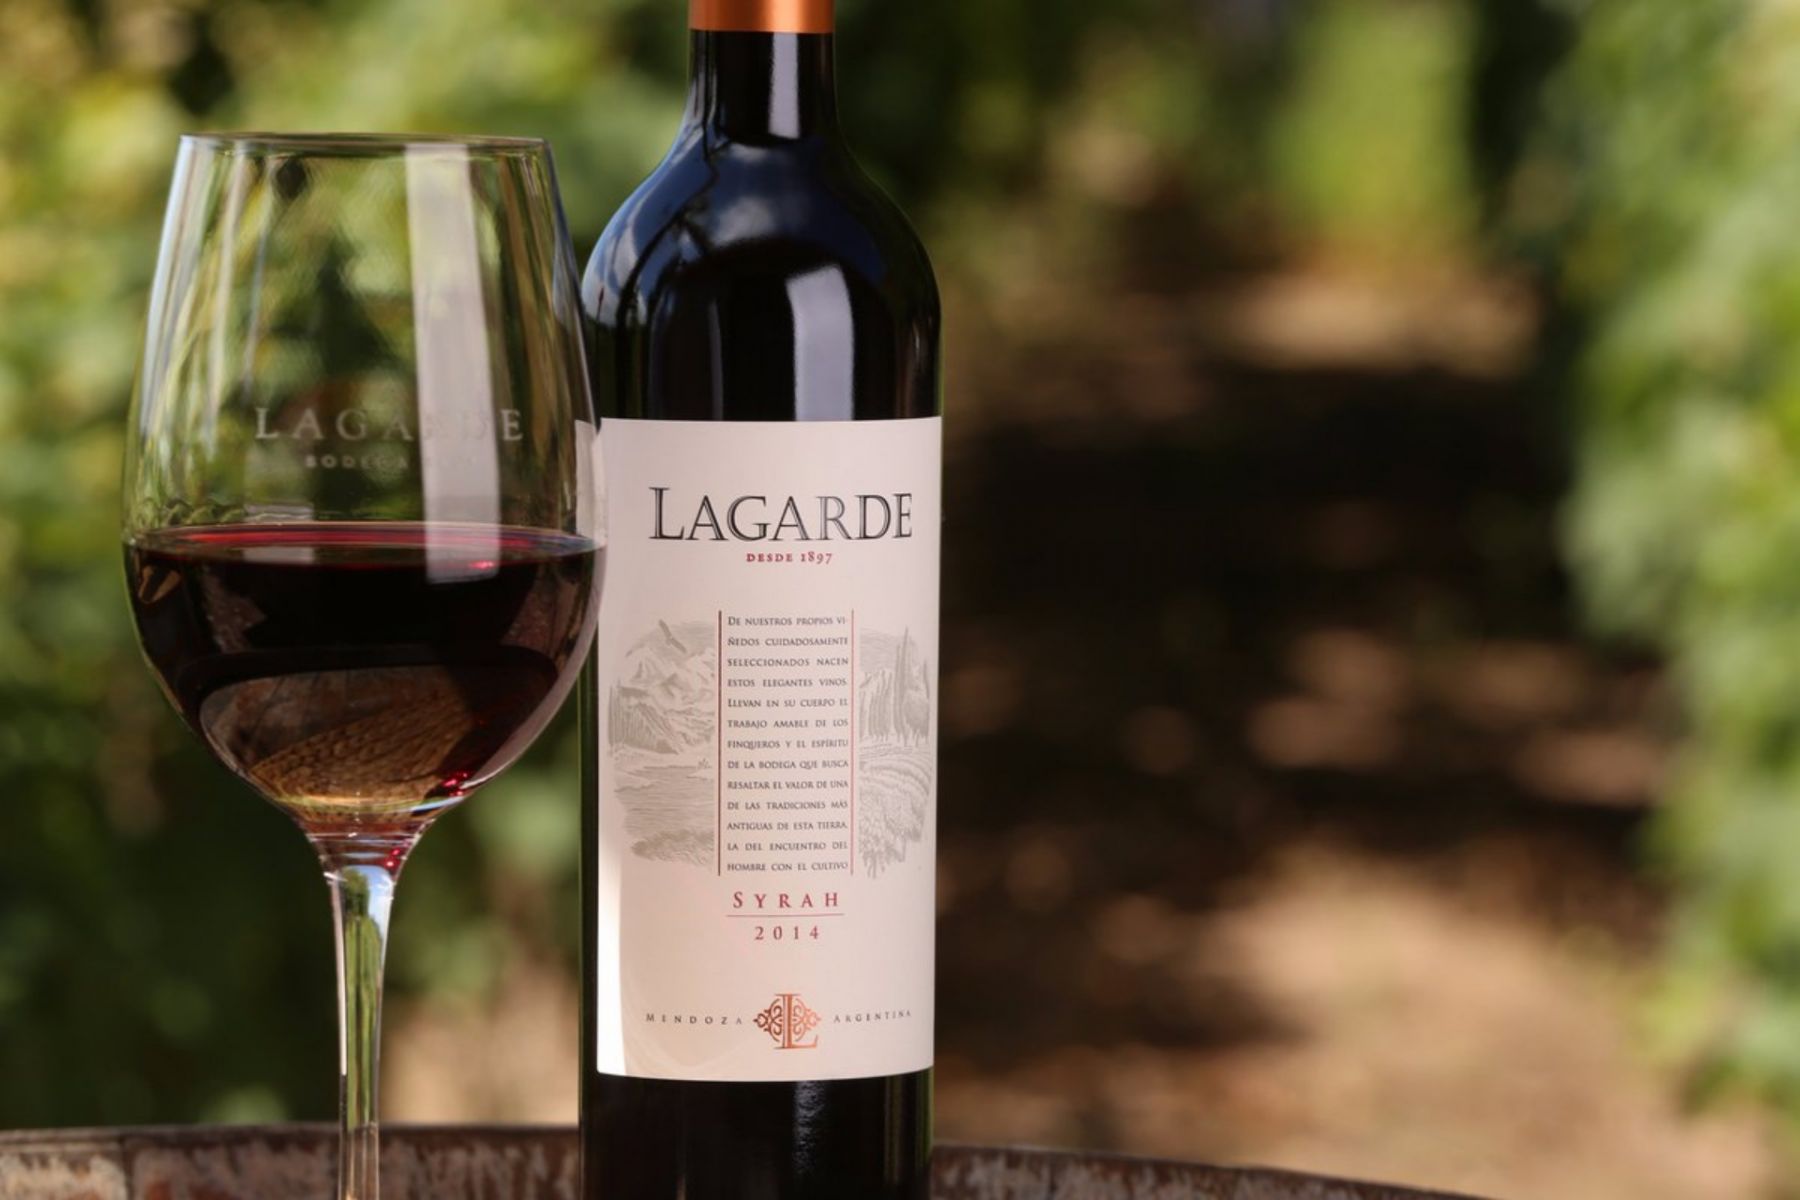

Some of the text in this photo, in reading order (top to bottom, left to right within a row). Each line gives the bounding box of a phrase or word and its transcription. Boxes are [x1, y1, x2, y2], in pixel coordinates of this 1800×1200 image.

[303, 454, 409, 469] BODEGA
[648, 487, 912, 542] LAGARDE
[746, 551, 832, 564] DESDE 1897
[728, 616, 741, 626] DE
[745, 617, 792, 626] NUESTROS
[796, 617, 833, 626] PROPIOS
[727, 637, 848, 647] ÑEDOS CUIDADOSAMENTE
[727, 656, 848, 667] SELECCIONADOS NACEN
[727, 678, 755, 687] ESTOS
[763, 679, 813, 687] ELEGANTES
[728, 698, 848, 708] LLEVAN EN SU CUERPO EL
[727, 719, 848, 729] TRABAJO AMABLE DE LOS
[727, 740, 780, 751] FINQUEROS
[785, 740, 792, 748] Y
[796, 740, 806, 748] EL
[727, 760, 848, 770] DE LA BODEGA QUE BUSCA
[727, 780, 848, 790] RESALTAR EL VALOR DE UNA
[727, 801, 739, 810] DE
[745, 802, 761, 810] LAS
[766, 801, 826, 810] TRADICIONES
[727, 822, 773, 831] ANTIGUAS
[777, 822, 789, 830] DE
[793, 822, 814, 830] ESTA
[727, 841, 847, 851] LA DEL ENCUENTRO DEL
[727, 862, 848, 872] HOMBRE CON EL CULTIVO
[733, 891, 838, 909] SYRAH
[754, 925, 819, 940] 2014
[646, 1013, 742, 1025] MENDOZA
[834, 1011, 910, 1023] ARGENTINA
